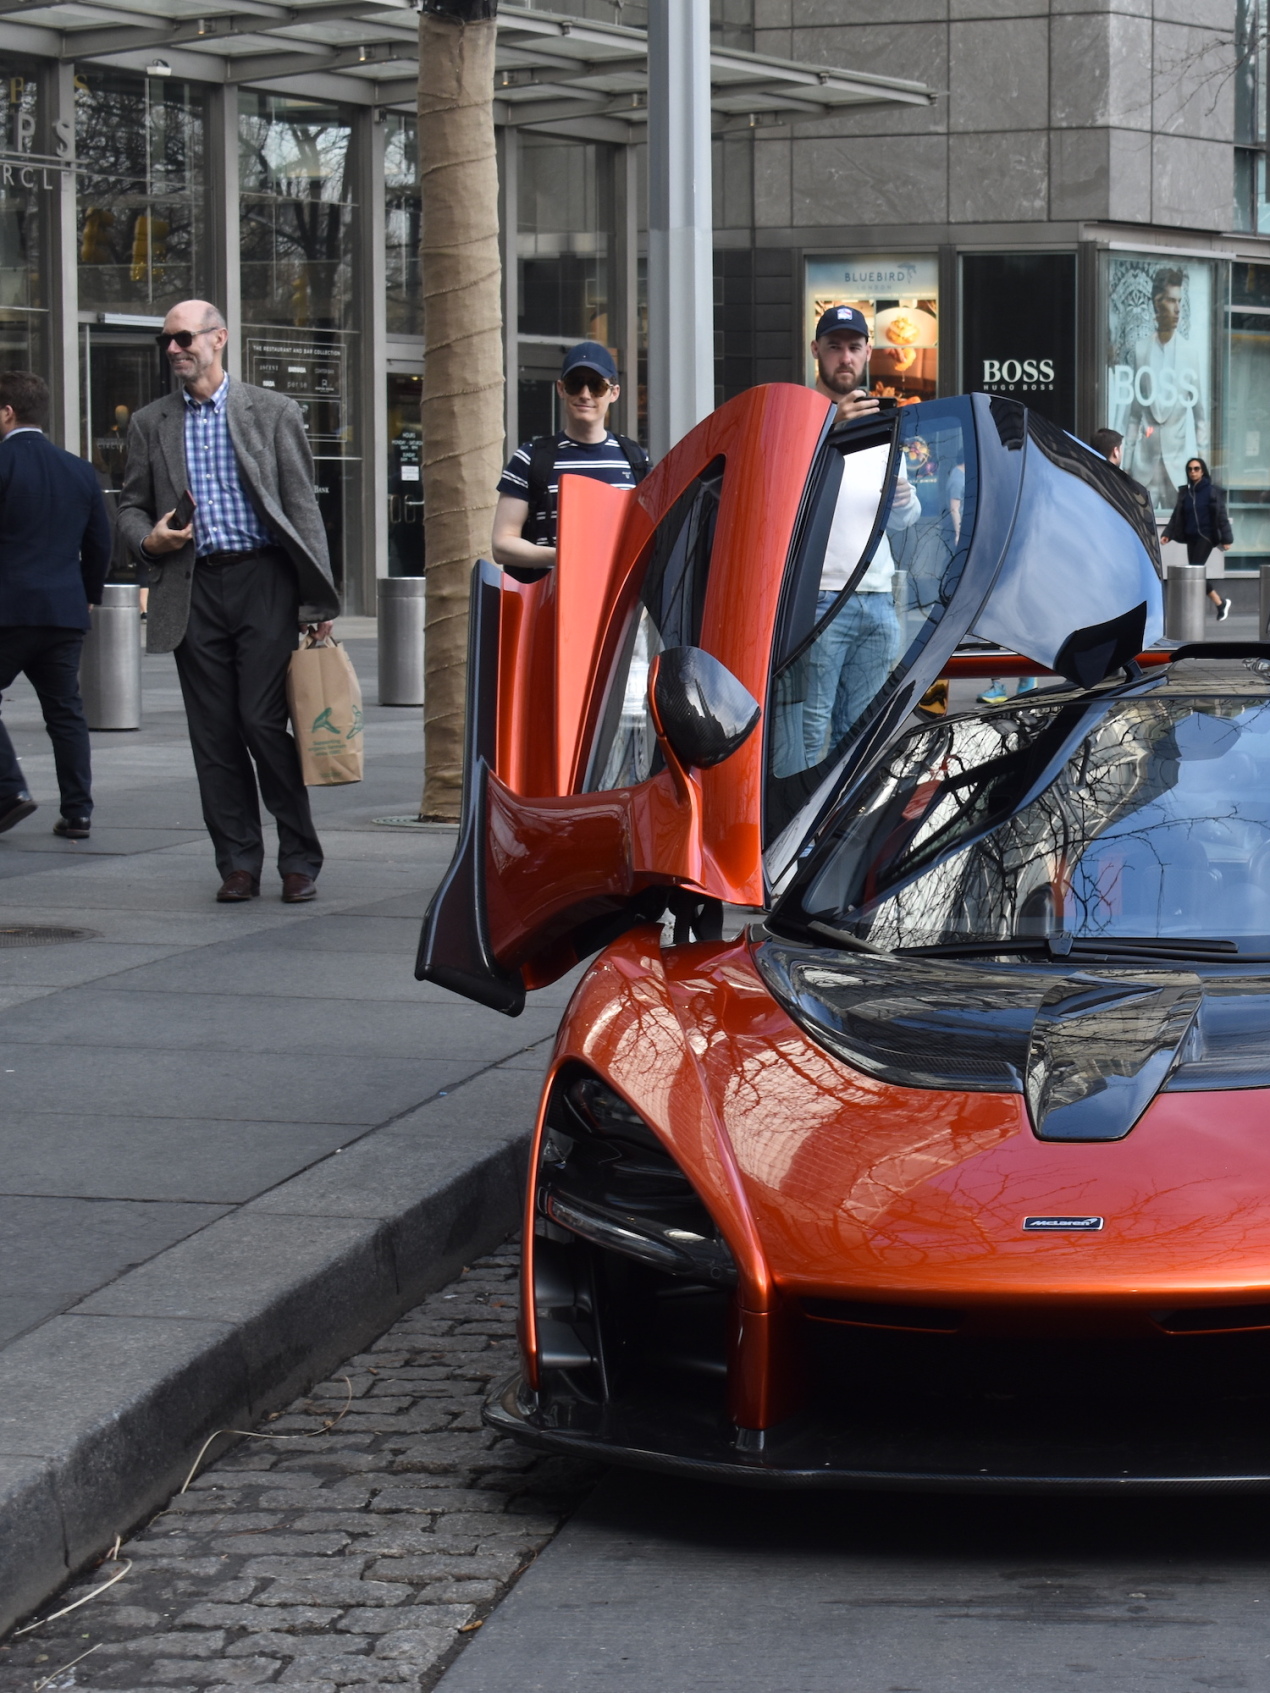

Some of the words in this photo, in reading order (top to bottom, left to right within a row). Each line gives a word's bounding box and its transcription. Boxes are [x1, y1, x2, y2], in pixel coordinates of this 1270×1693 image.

[845, 272, 905, 282] BLUEBIRD
[983, 359, 1055, 383] BOSS
[1114, 365, 1199, 408] BOSS
